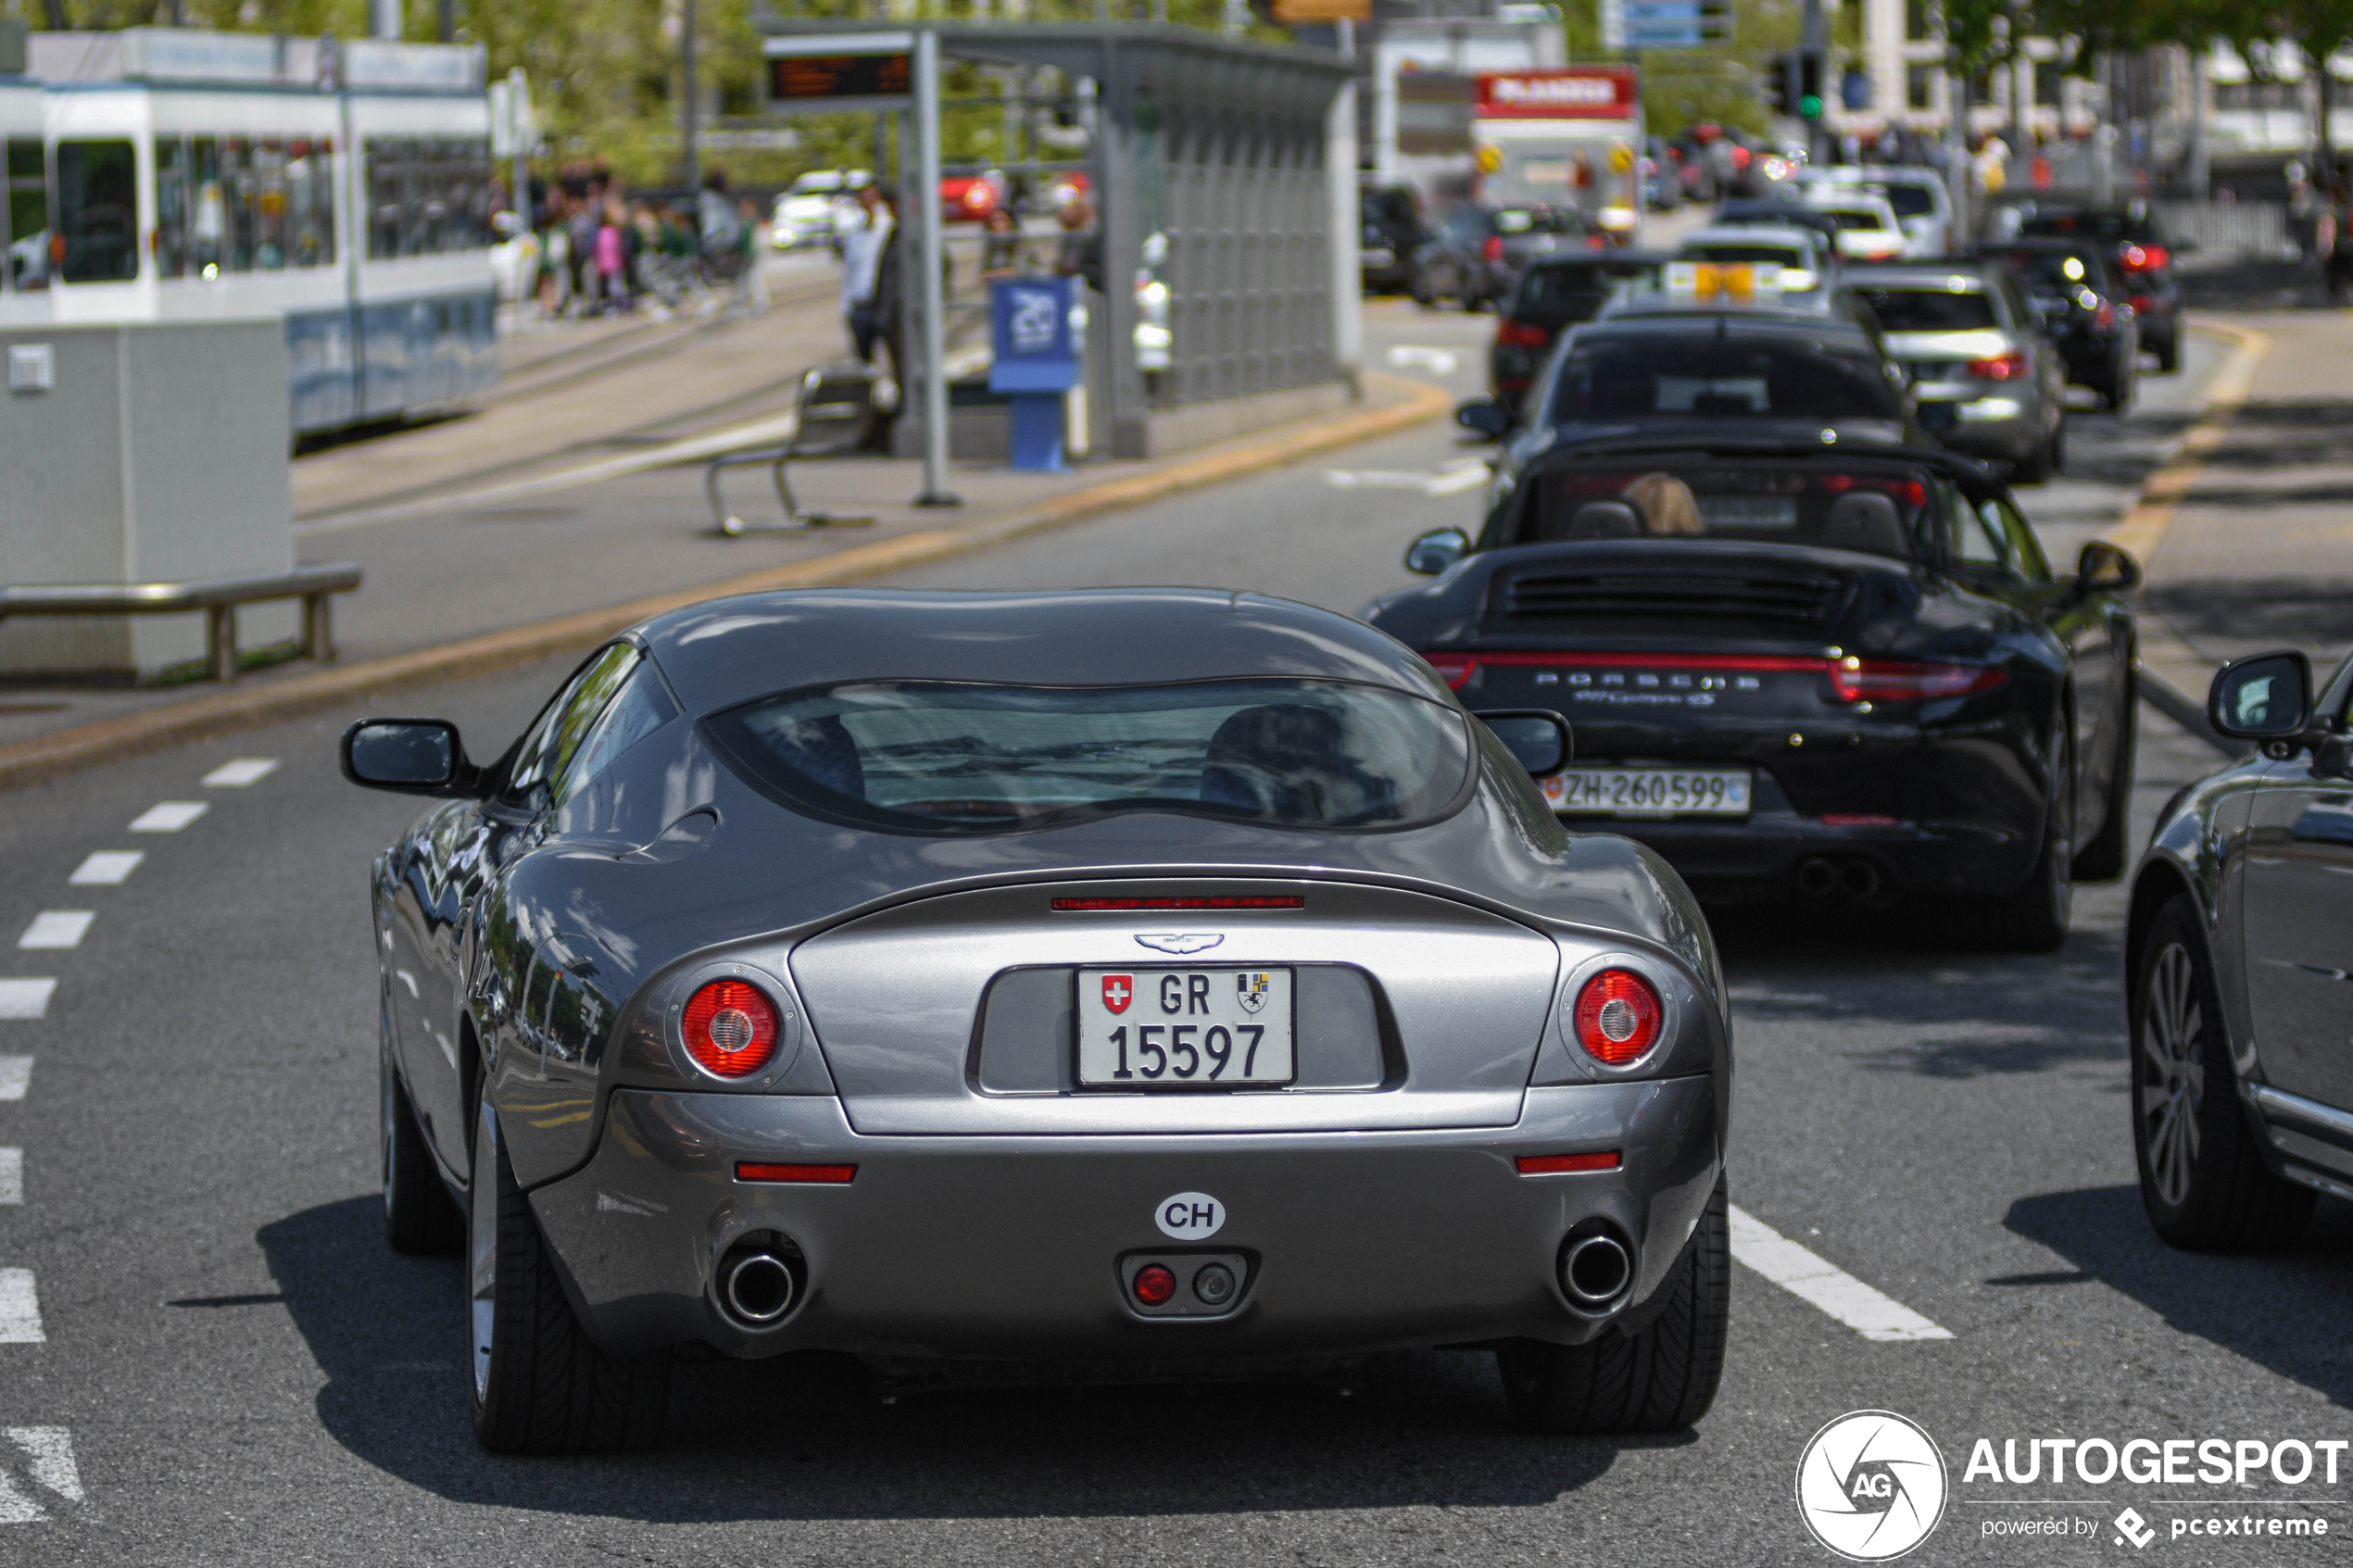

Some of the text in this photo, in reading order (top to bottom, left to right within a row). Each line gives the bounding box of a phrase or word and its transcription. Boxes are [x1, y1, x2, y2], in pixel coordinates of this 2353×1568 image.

[1535, 673, 1759, 690] PORSCHE
[1161, 974, 1210, 1014] GR
[1109, 1024, 1265, 1080] 15597
[1165, 1202, 1214, 1228] CH
